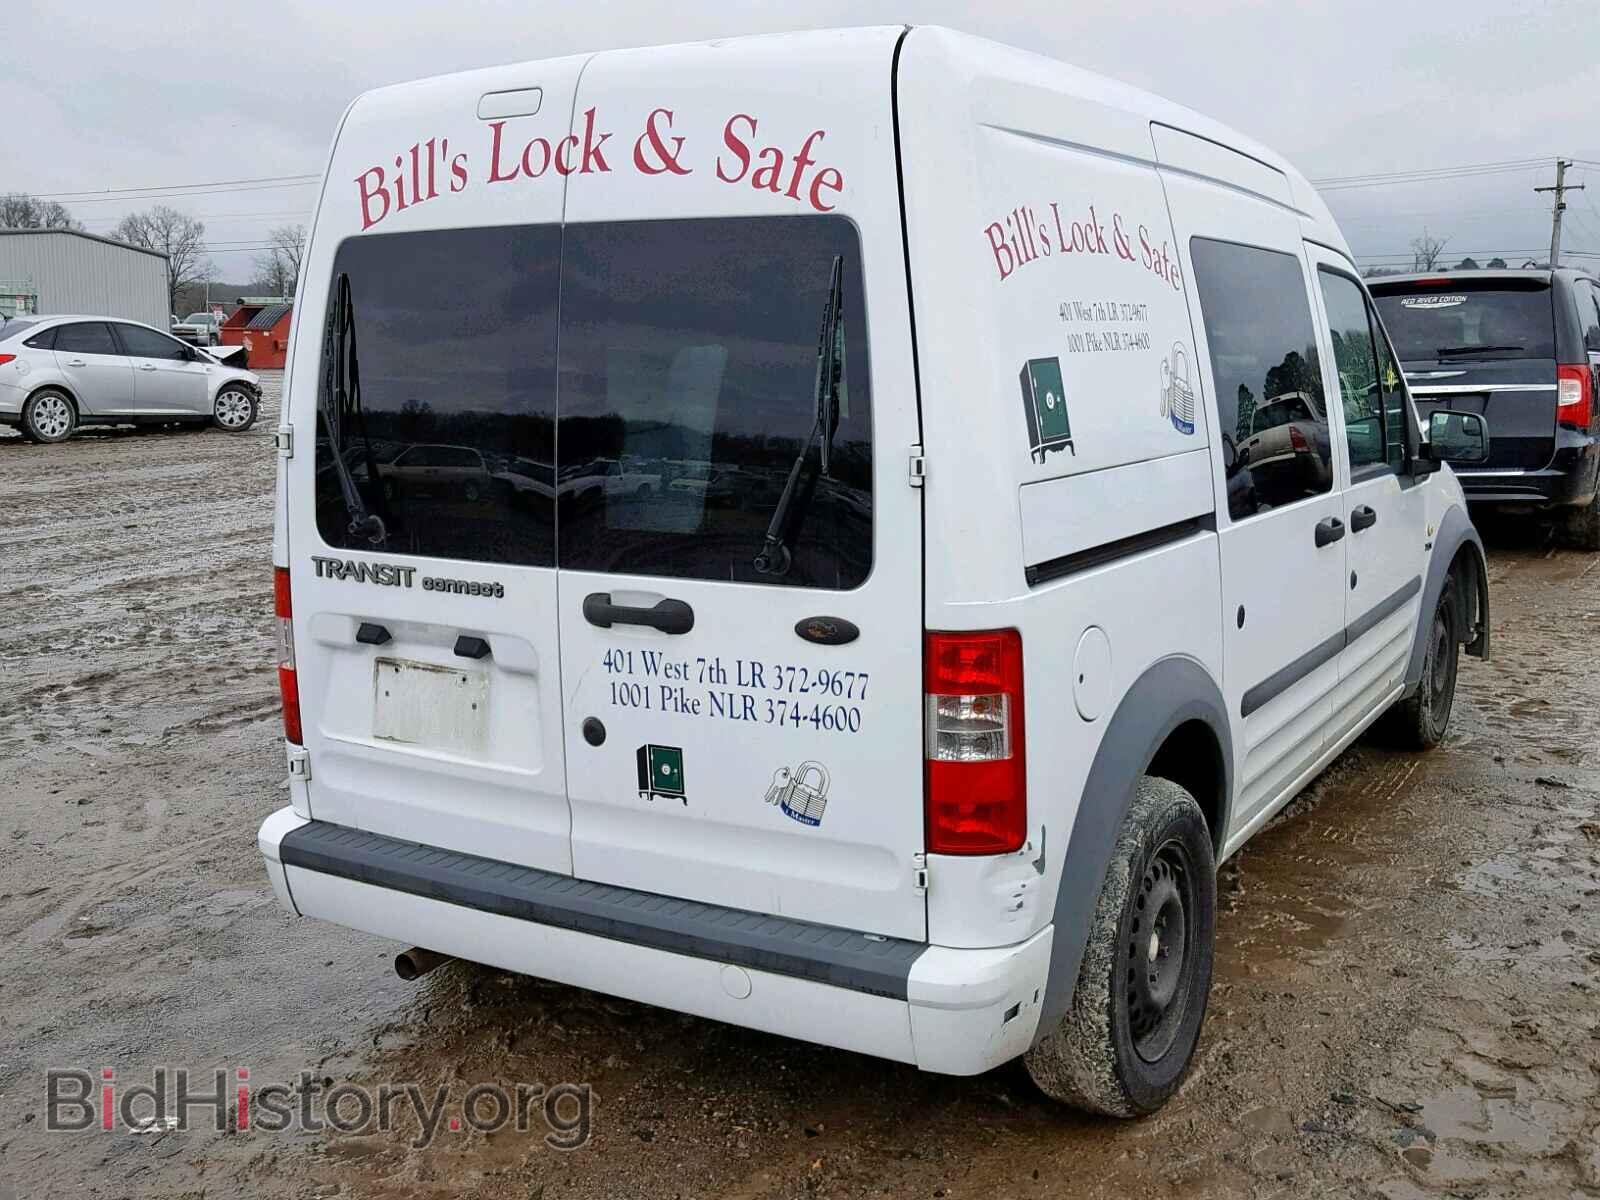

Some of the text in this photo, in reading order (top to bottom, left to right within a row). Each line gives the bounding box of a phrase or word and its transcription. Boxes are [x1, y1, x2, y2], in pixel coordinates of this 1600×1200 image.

[354, 106, 844, 232] Bill's Lock & Safe
[984, 202, 1182, 291] Bill's Lock & Safe
[1059, 301, 1148, 322] 401 West 7th LR 372-9677
[1439, 295, 1468, 303] EDITION
[1067, 332, 1150, 353] 1001 Pike NLR 374-4600
[312, 556, 504, 598] TRANSIT connect
[603, 648, 869, 700] 401 West 7th LR 372-9677
[610, 682, 861, 733] 1001 Pike NLR 374-4600
